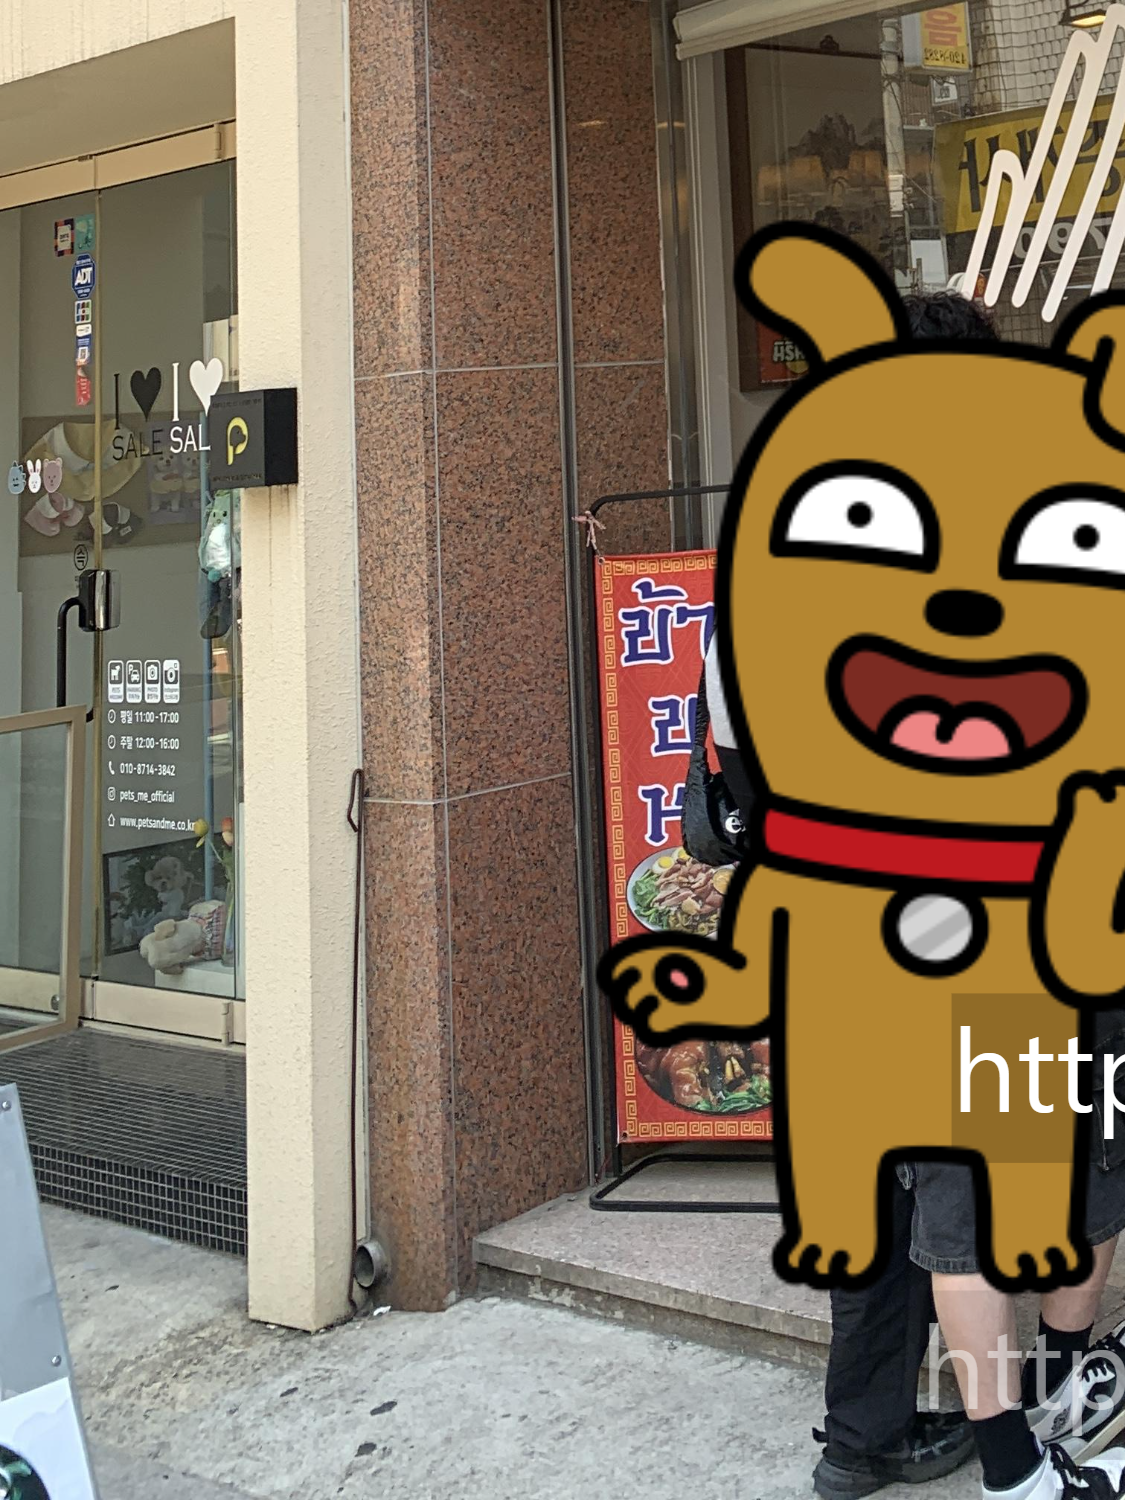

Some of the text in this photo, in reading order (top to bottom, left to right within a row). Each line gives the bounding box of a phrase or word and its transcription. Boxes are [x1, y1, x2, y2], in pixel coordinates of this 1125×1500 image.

[74, 267, 93, 286] ADT
[112, 429, 164, 461] SALE
[170, 424, 212, 454] SAL
[120, 710, 133, 724] 평일
[120, 736, 133, 749] 주말
